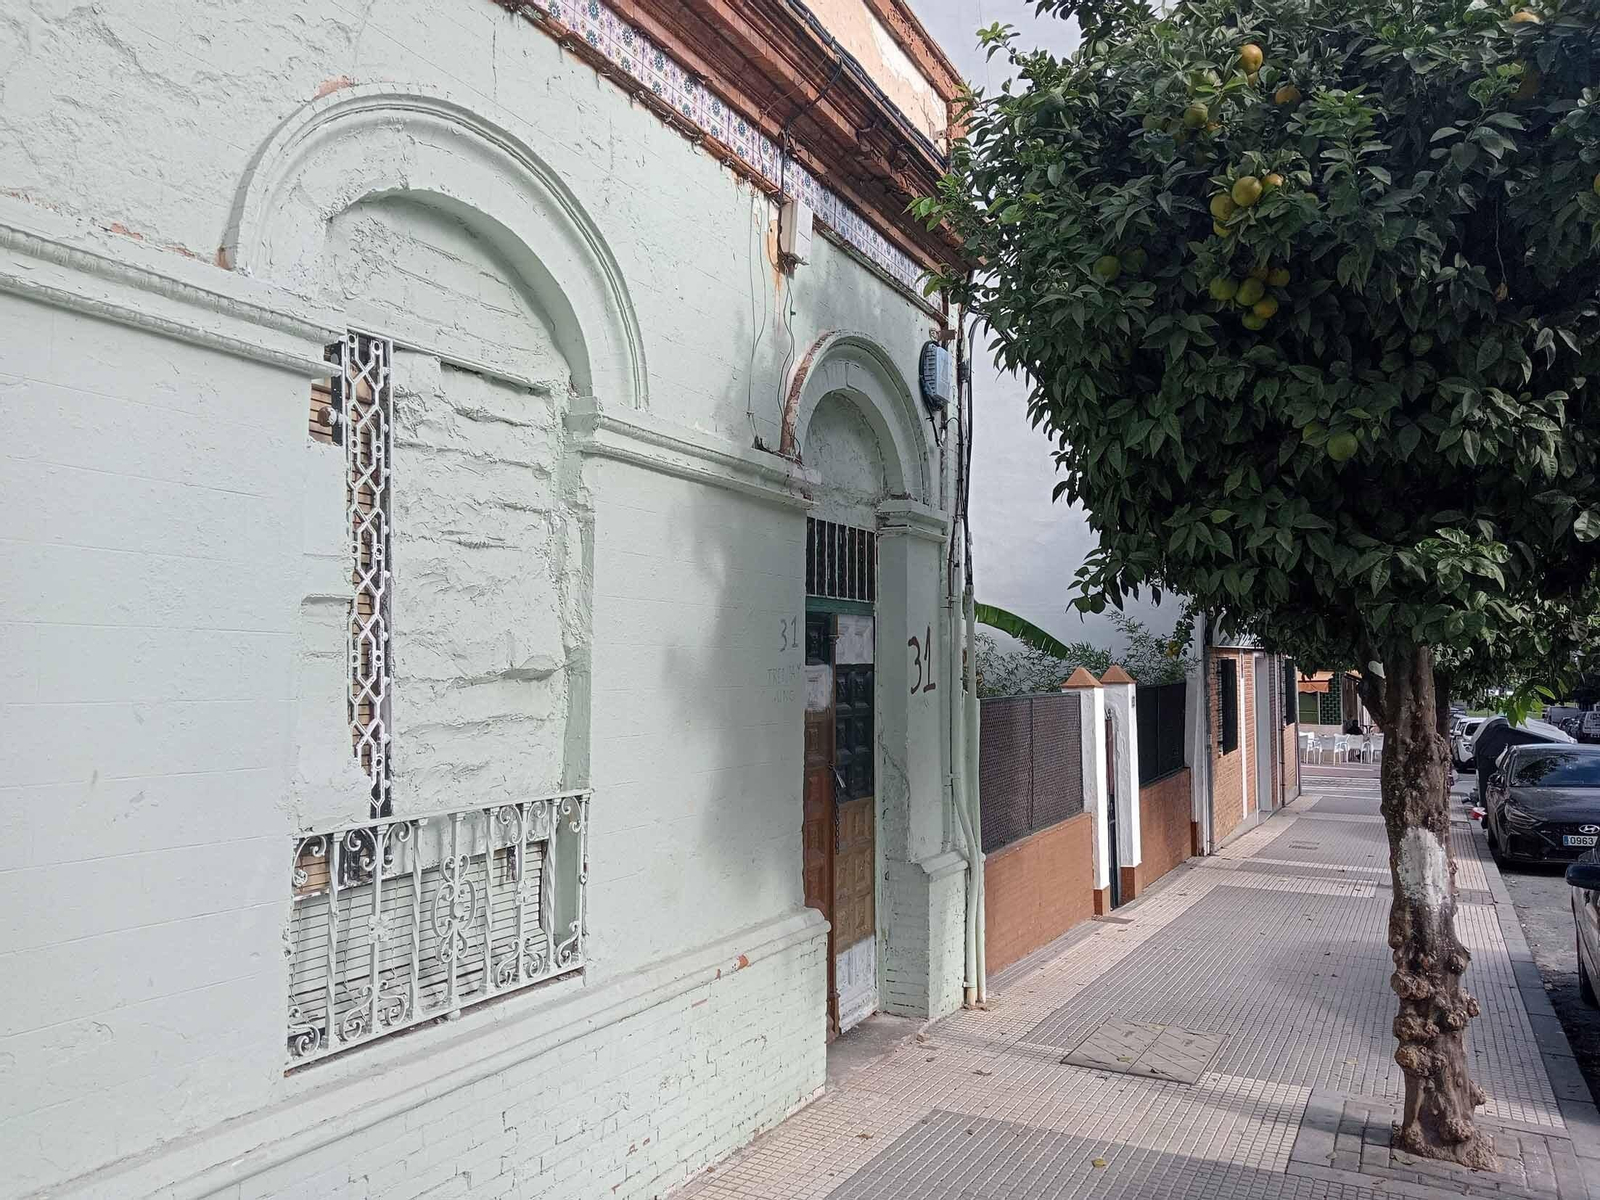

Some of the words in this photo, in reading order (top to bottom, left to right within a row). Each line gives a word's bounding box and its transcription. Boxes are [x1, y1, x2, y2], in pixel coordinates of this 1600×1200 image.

[779, 615, 799, 652] 31
[908, 625, 936, 695] 31
[1570, 836, 1594, 845] 0963
